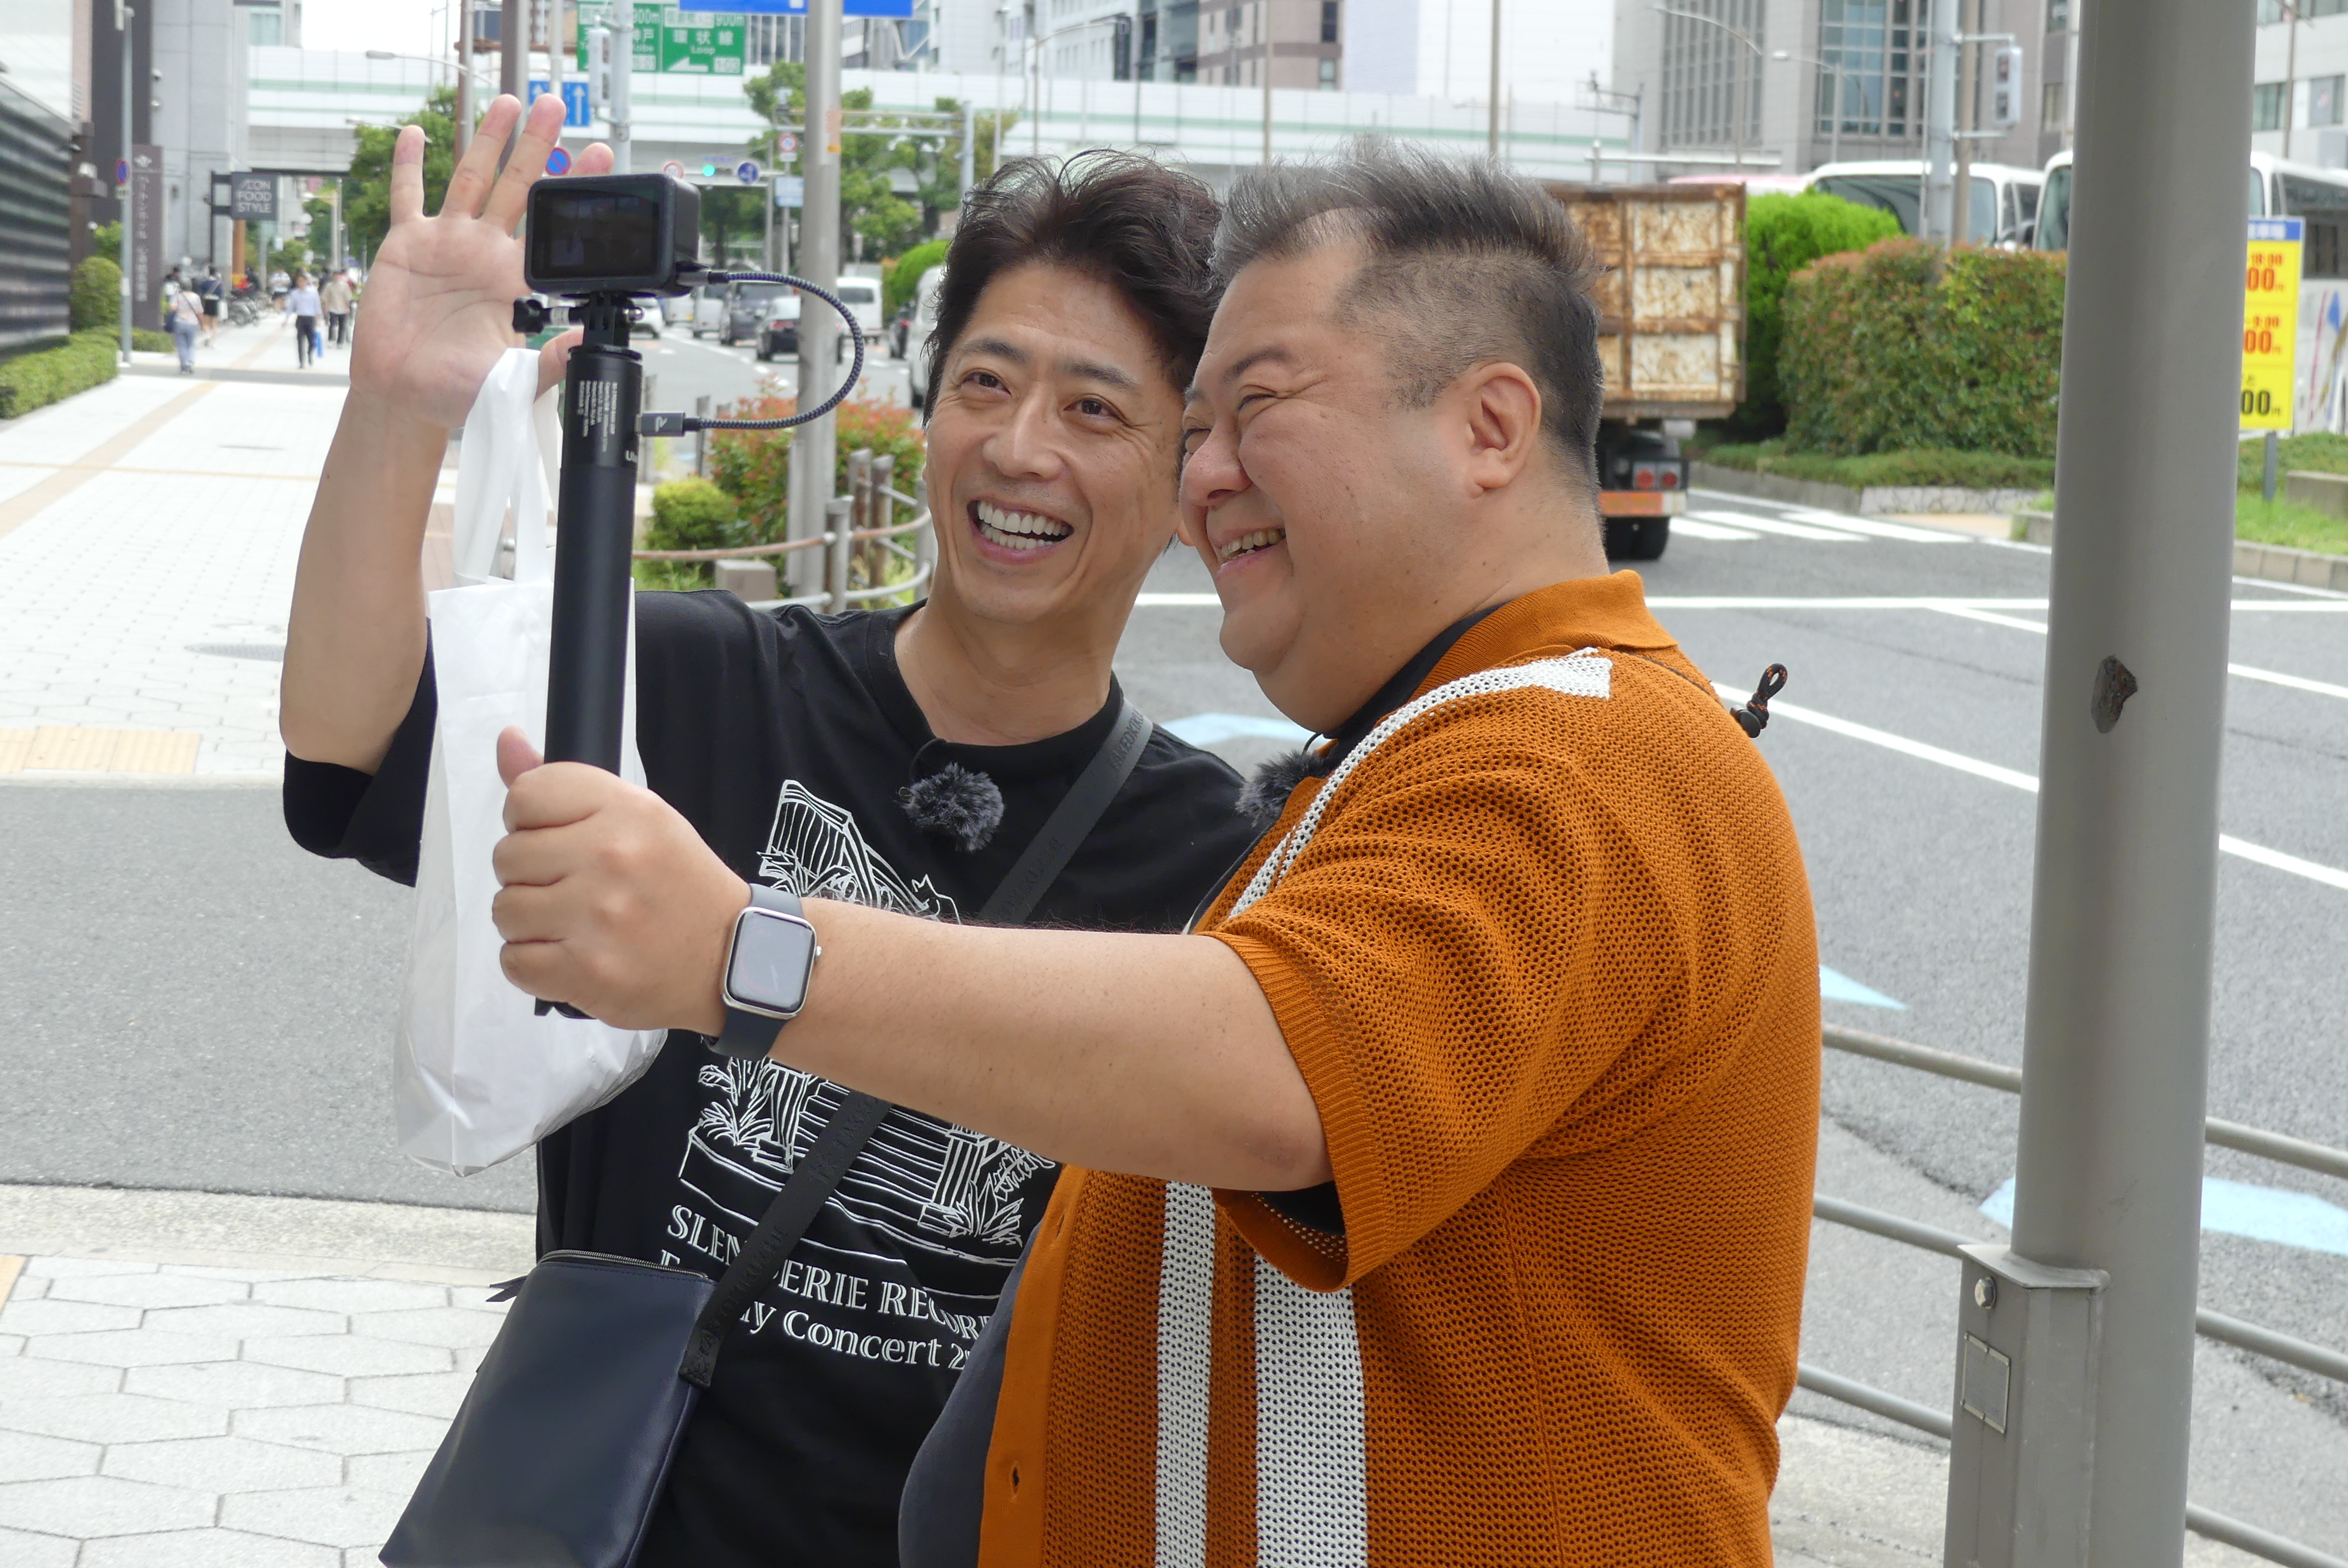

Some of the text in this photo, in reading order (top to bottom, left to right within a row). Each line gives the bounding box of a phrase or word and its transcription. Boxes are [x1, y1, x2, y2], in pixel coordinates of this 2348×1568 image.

[238, 191, 272, 202] FOOD
[238, 202, 272, 213] STYLE
[783, 1309, 942, 1367] Concert
[947, 1343, 970, 1370] 2
